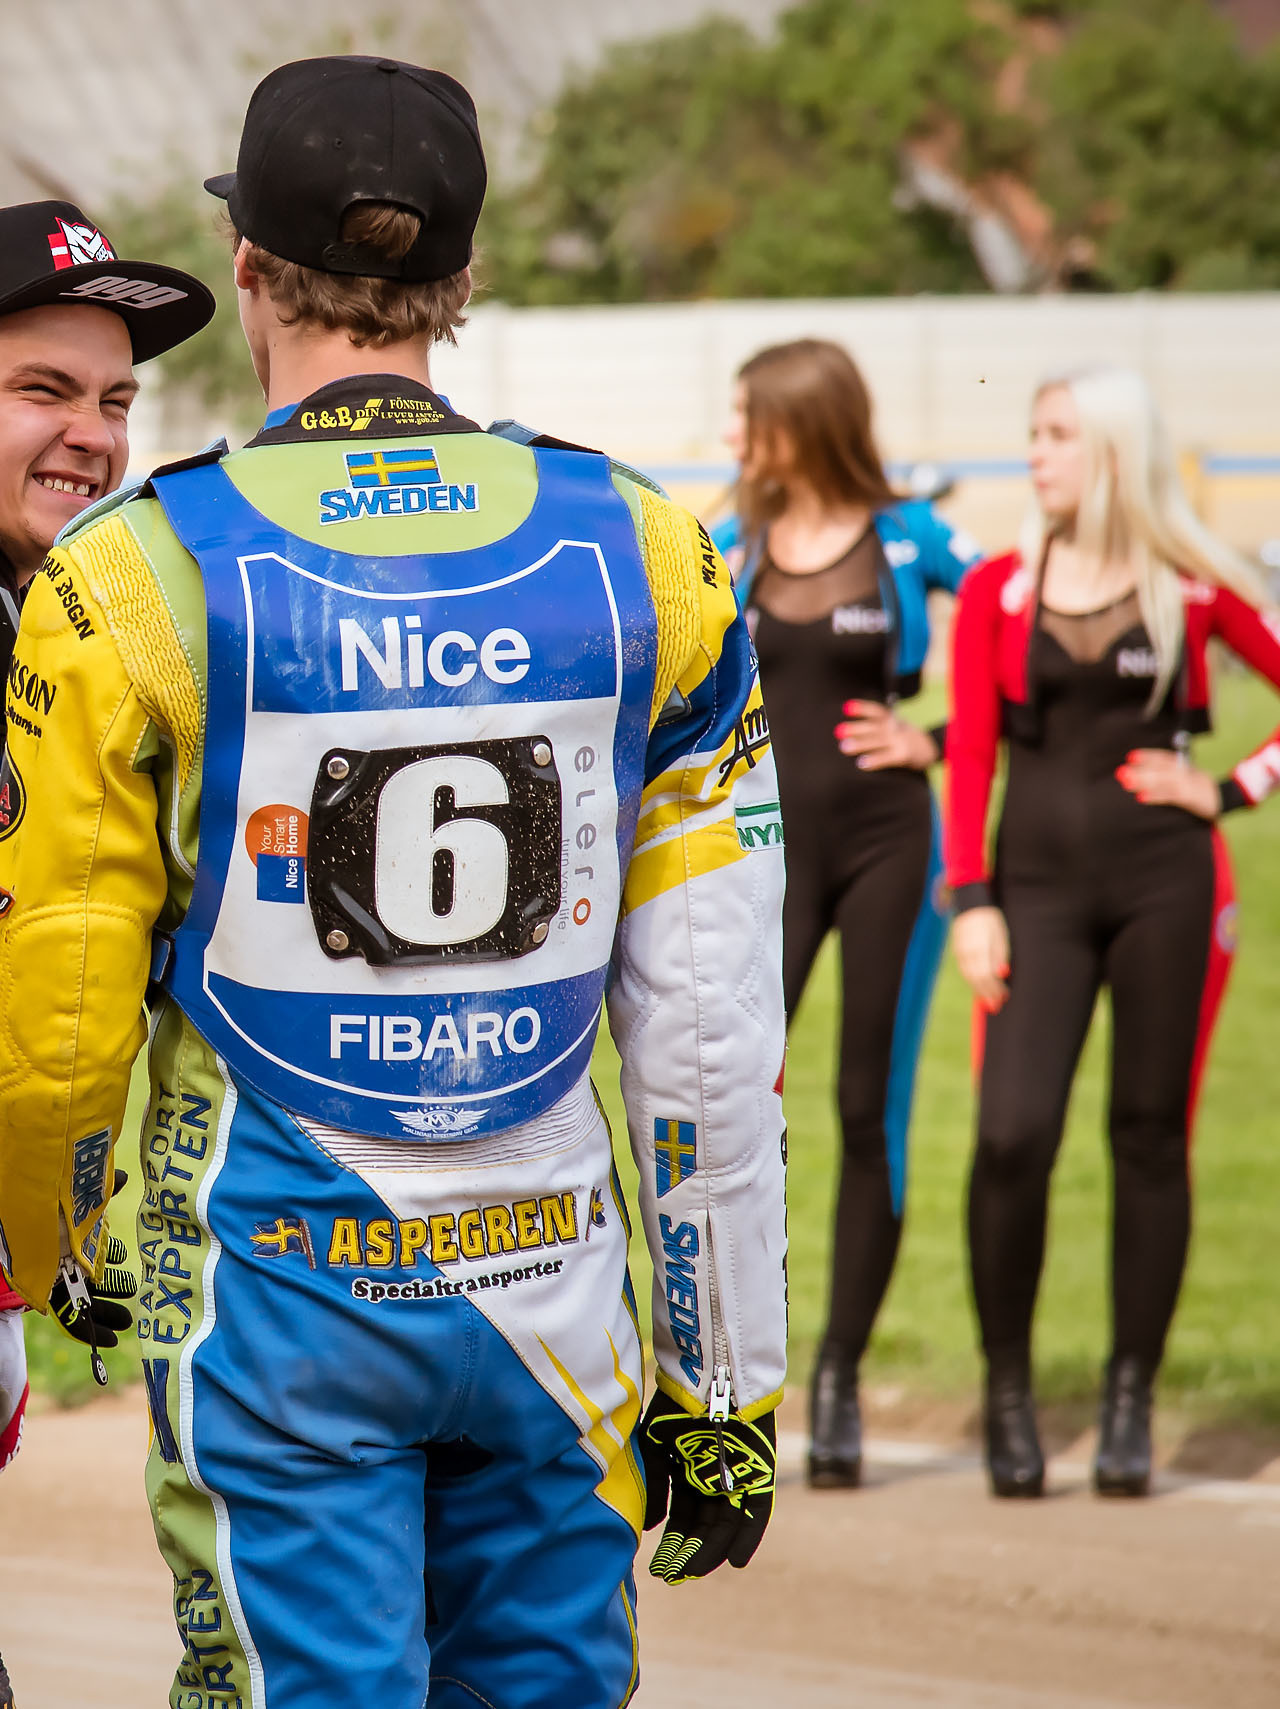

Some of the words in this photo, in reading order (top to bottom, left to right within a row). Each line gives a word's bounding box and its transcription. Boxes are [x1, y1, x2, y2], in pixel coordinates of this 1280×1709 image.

[300, 406, 353, 431] G&B
[389, 397, 433, 411] FÖNSTER
[320, 484, 477, 523] SWEDEN
[338, 615, 531, 692] Nice
[261, 825, 272, 851] Your
[274, 816, 286, 854] Smart
[286, 815, 298, 854] Home
[375, 755, 510, 945] 6
[285, 859, 298, 888] Nice
[557, 908, 570, 930] life
[330, 1006, 541, 1060] FIBARO
[153, 1093, 211, 1344] EXPERTEN
[328, 1192, 578, 1268] ASPEGREN
[353, 1258, 563, 1302] Specialtransporter
[659, 1213, 702, 1388] SWEDEN
